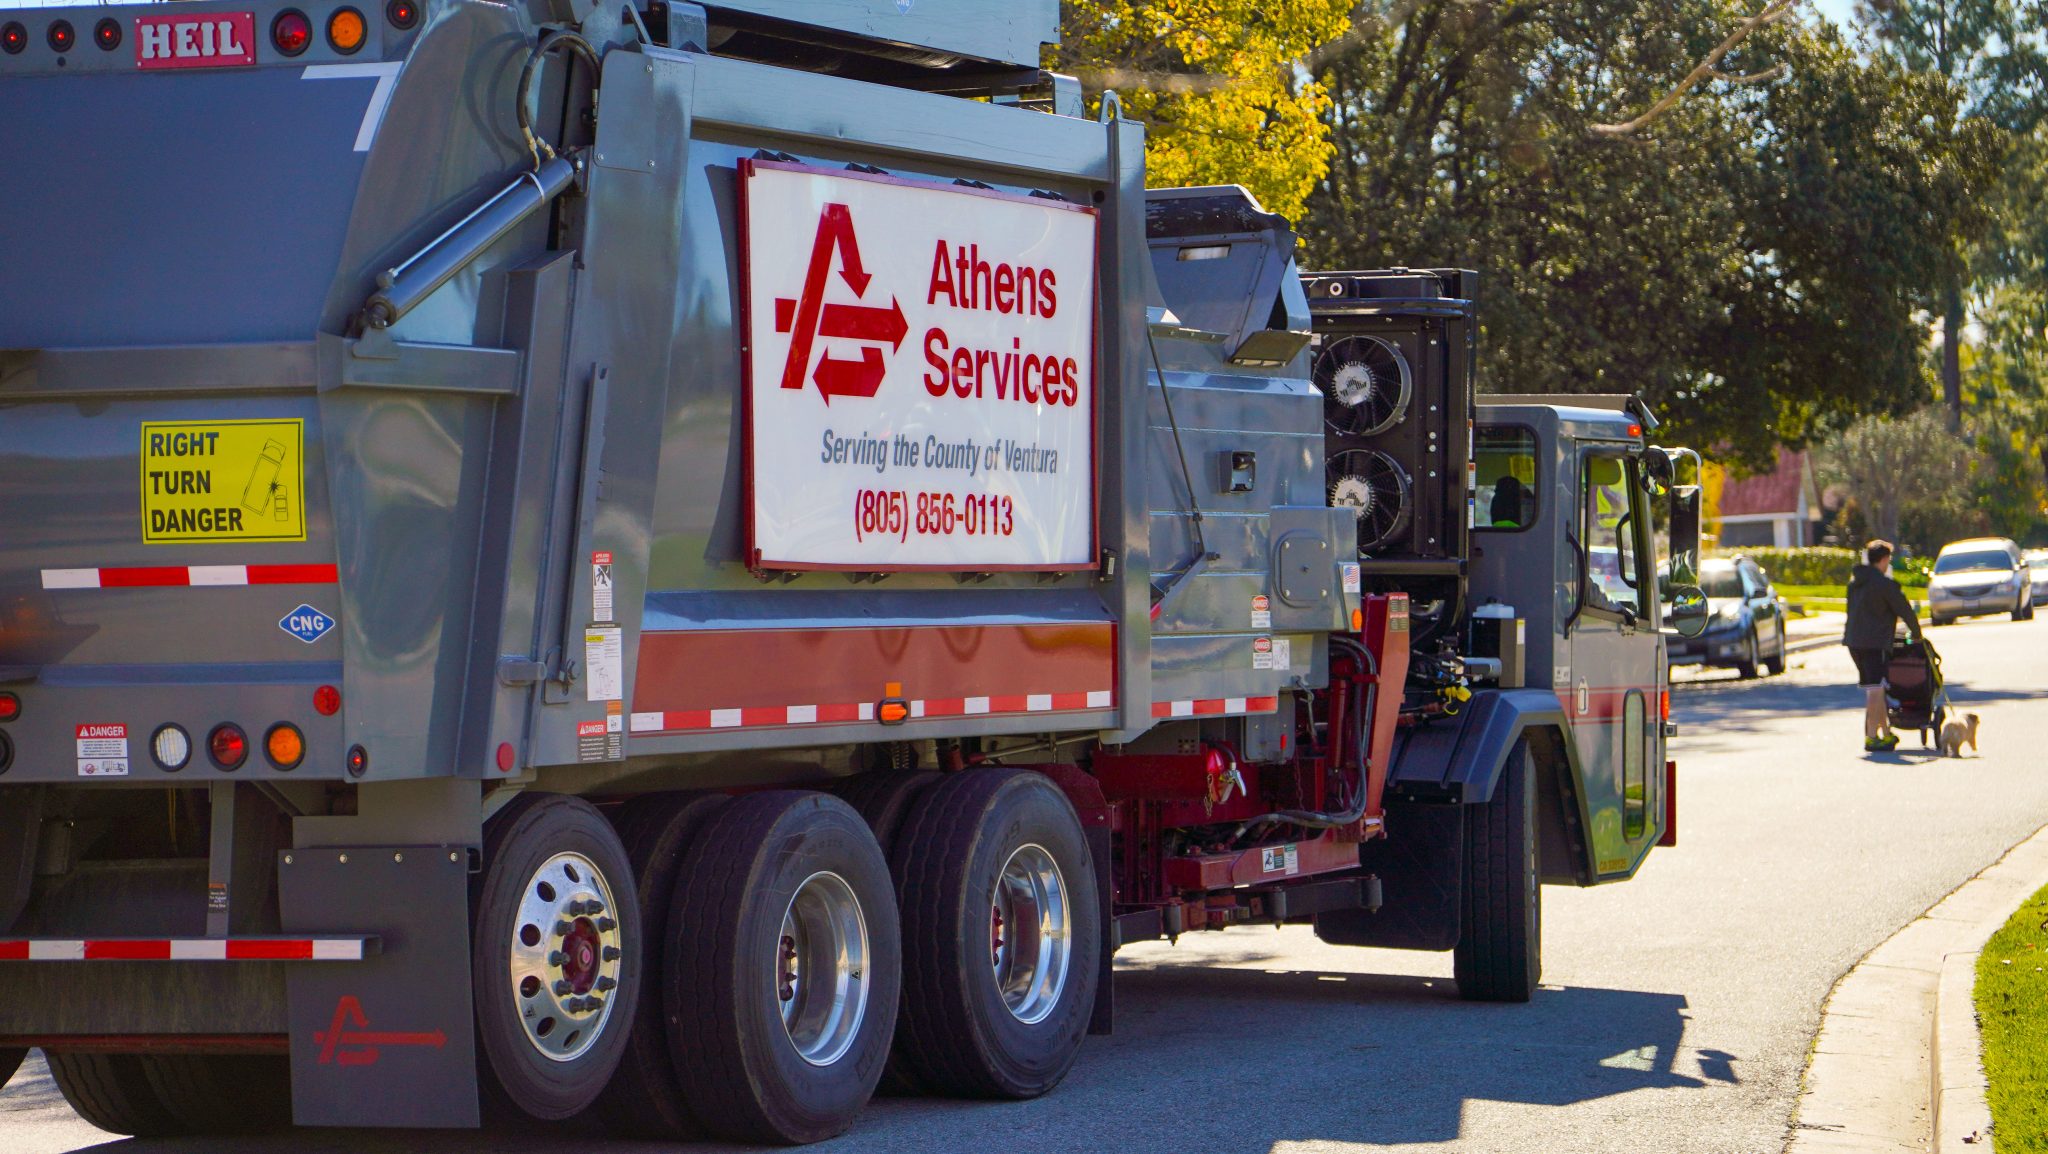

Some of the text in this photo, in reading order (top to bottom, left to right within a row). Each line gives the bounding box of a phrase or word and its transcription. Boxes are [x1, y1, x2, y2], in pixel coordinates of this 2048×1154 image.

[140, 21, 245, 59] HEIL
[927, 239, 1057, 319] Athens
[923, 327, 1078, 407] Services
[150, 432, 220, 457] RIGHT
[821, 429, 1058, 477] Serving the County of Ventura
[149, 470, 211, 495] TURN
[151, 508, 244, 533] DANGER
[855, 489, 1013, 543] (805) 856-0113
[290, 615, 324, 632] CNG
[89, 726, 124, 737] DANGER
[585, 724, 604, 733] DANGER
